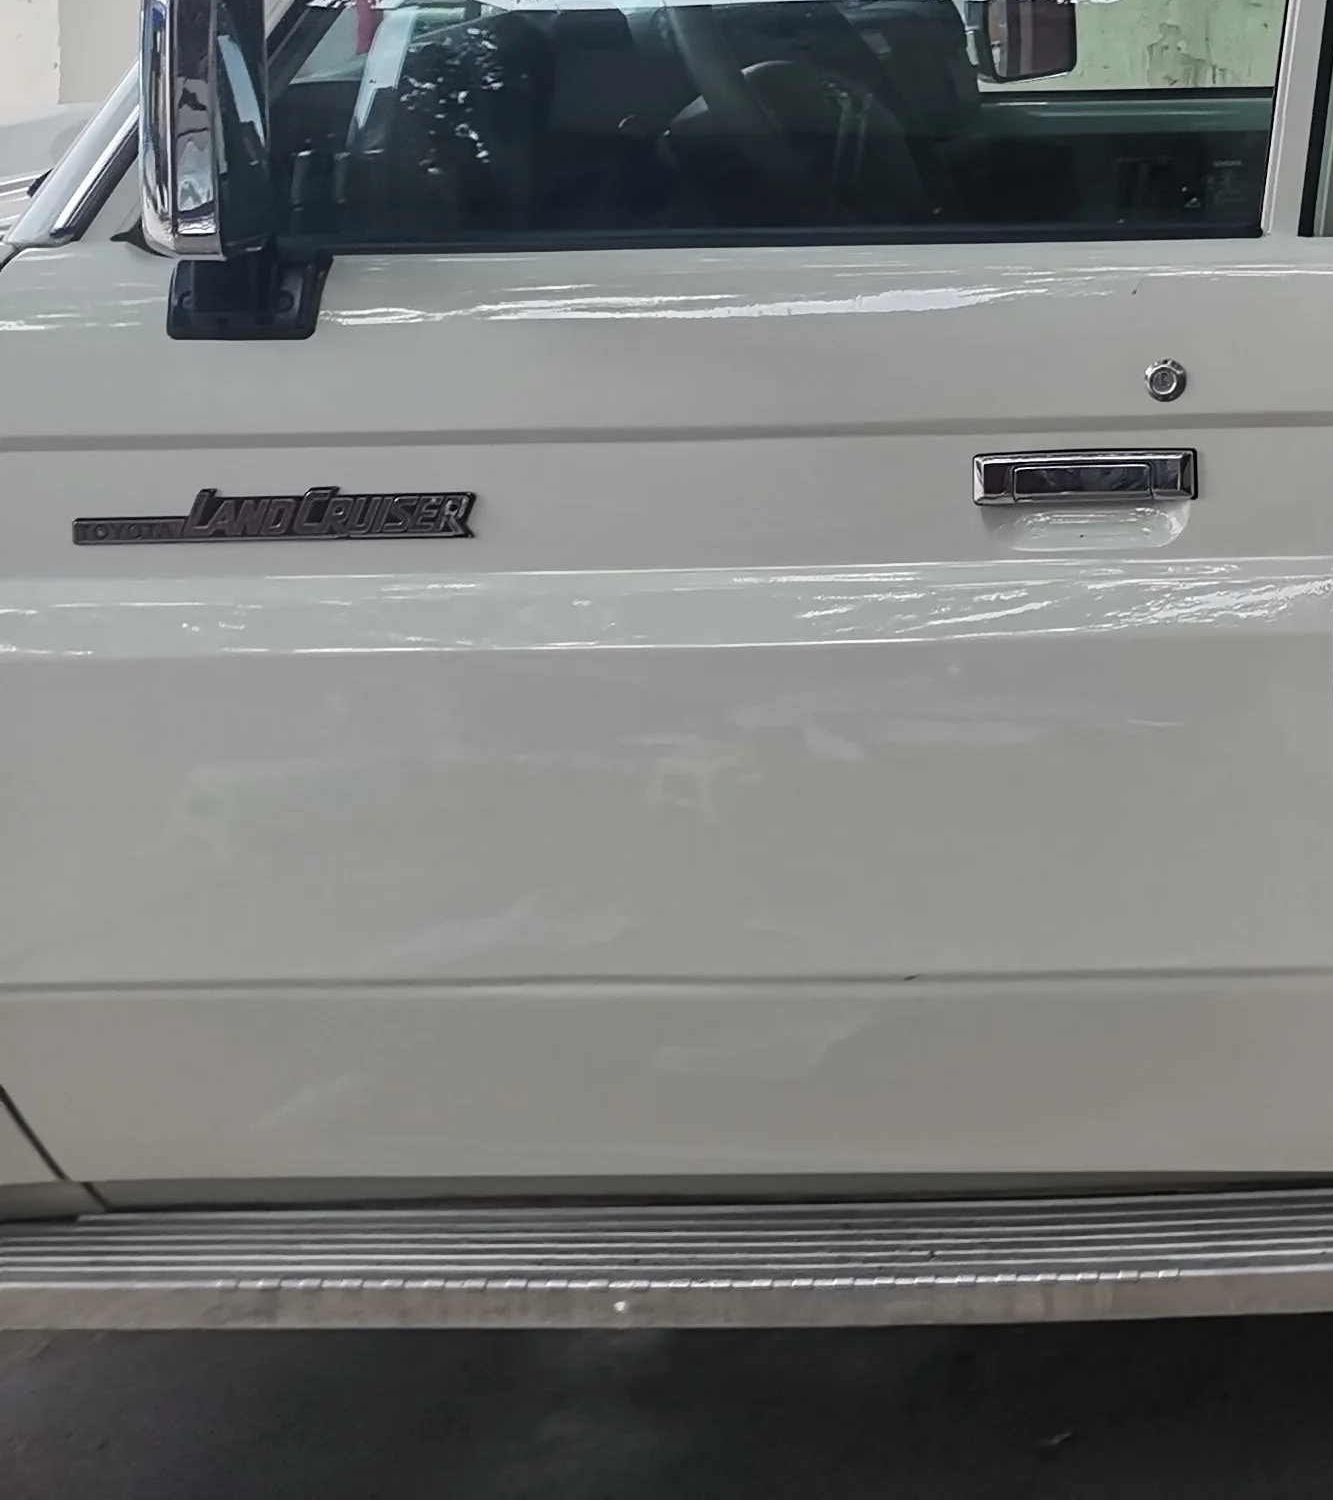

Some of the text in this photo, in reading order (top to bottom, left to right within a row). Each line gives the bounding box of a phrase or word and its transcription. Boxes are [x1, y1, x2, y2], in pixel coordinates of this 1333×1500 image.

[78, 486, 469, 541] TOYOTA LAND CRUISER
